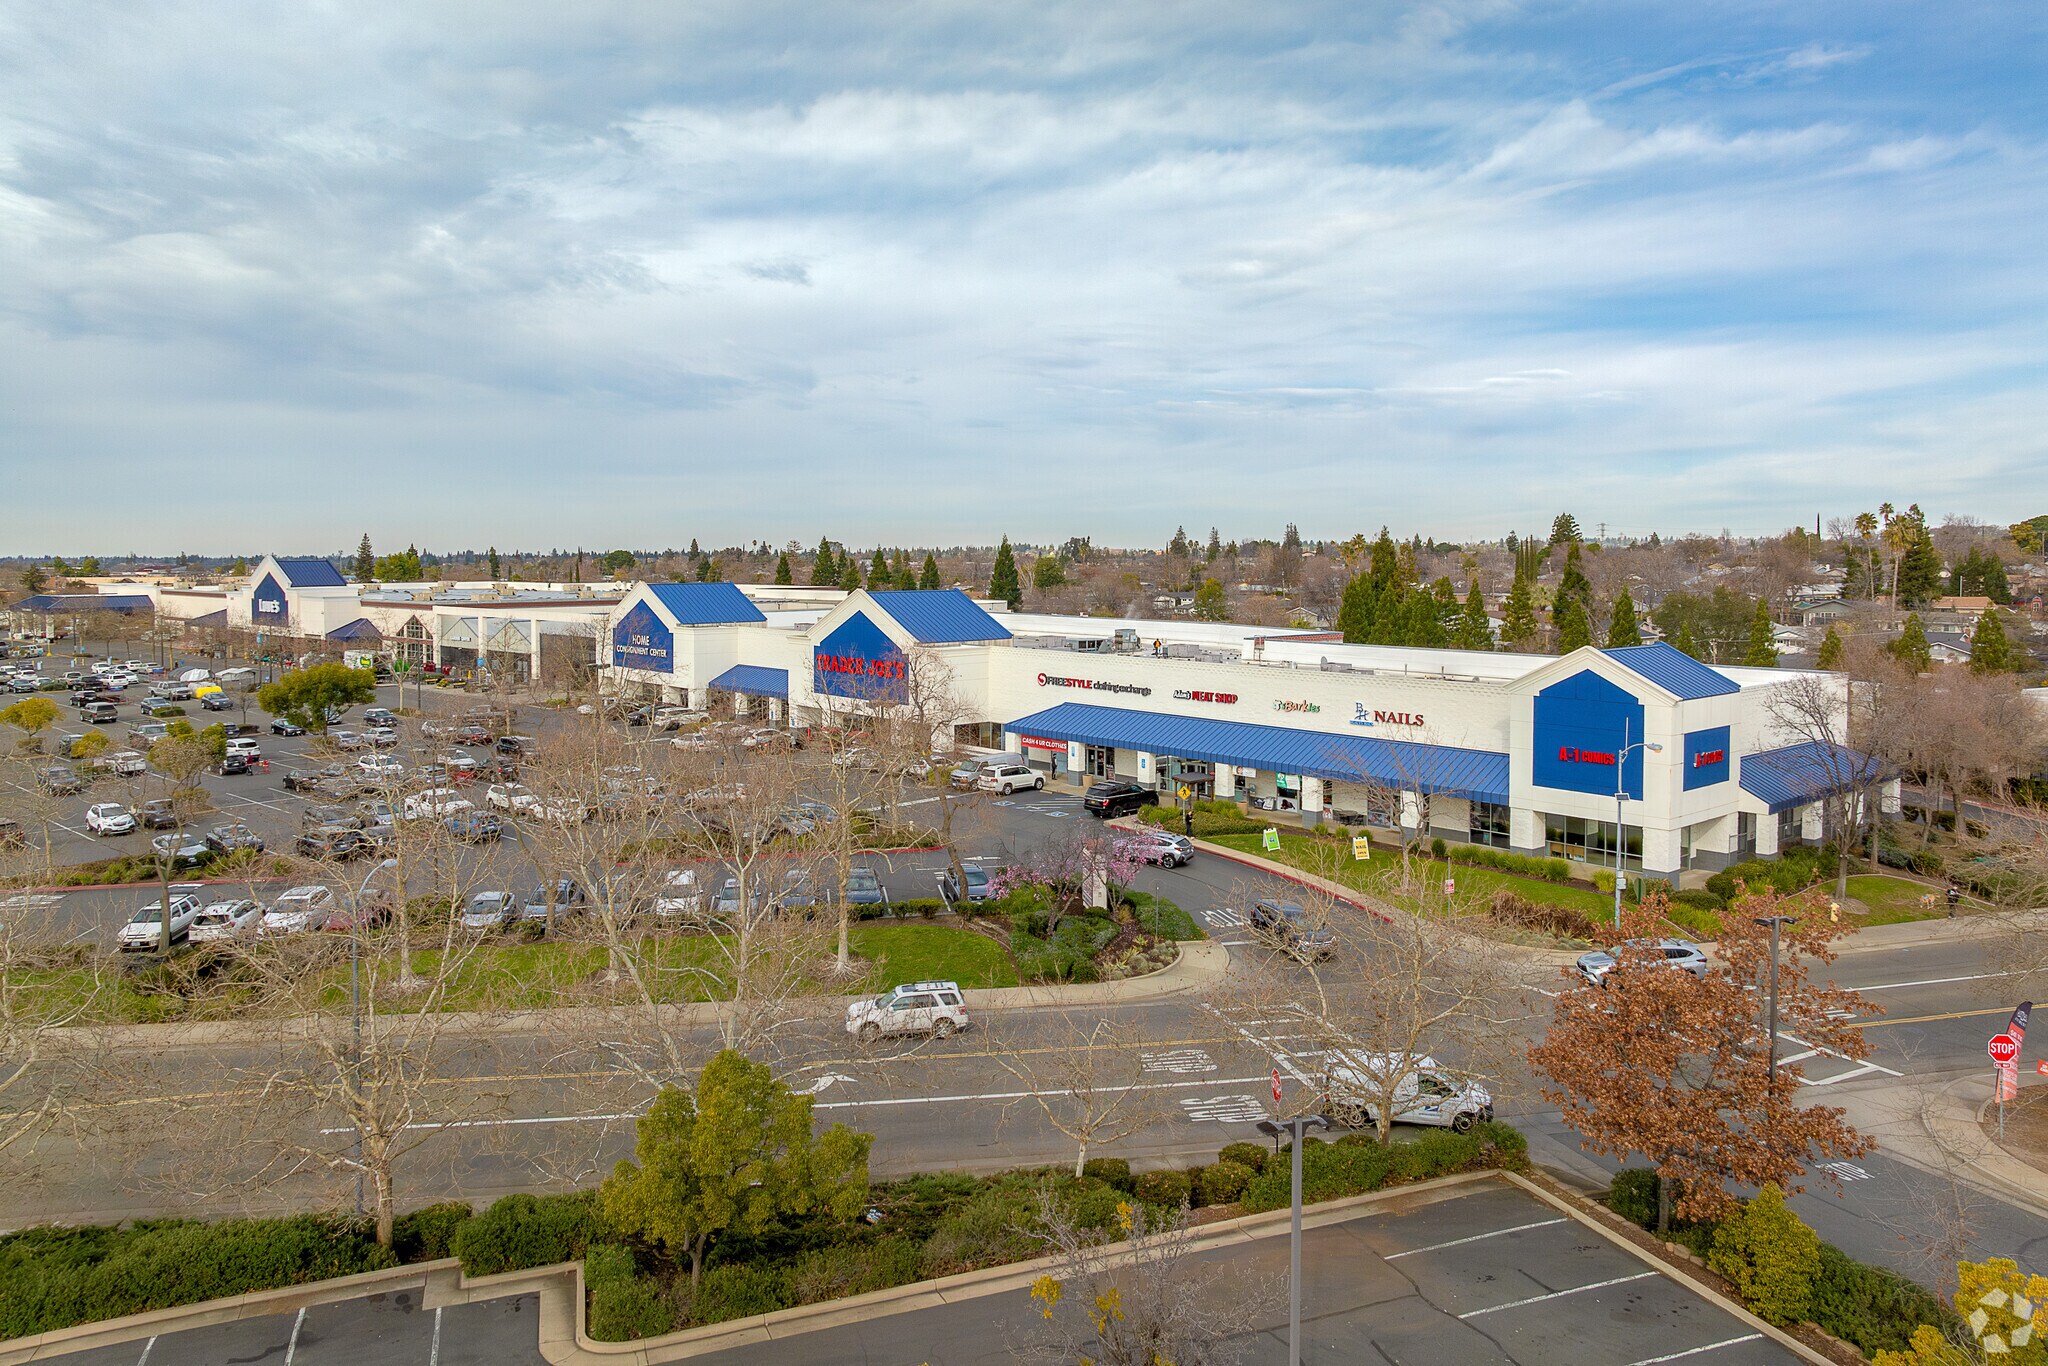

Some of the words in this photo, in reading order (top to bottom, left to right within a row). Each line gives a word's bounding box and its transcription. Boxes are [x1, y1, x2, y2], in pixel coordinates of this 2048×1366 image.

[632, 635, 650, 646] HOME
[649, 648, 667, 658] CENTER
[816, 654, 864, 675] TRADER
[867, 659, 905, 679] JOE'S
[1047, 676, 1092, 689] FREESTYLE
[1093, 680, 1120, 694] clothing
[1120, 684, 1151, 696] exchange
[1191, 691, 1214, 702] MEAT
[1214, 692, 1238, 704] SHOP
[1373, 710, 1425, 727] NAILS
[1022, 737, 1036, 745] CASH
[1045, 740, 1068, 750] CLOTHES
[1559, 746, 1581, 763] A-1
[1581, 750, 1616, 766] COMICS
[1990, 1043, 2014, 1054] STOP
[1179, 1094, 1270, 1123] STOP
